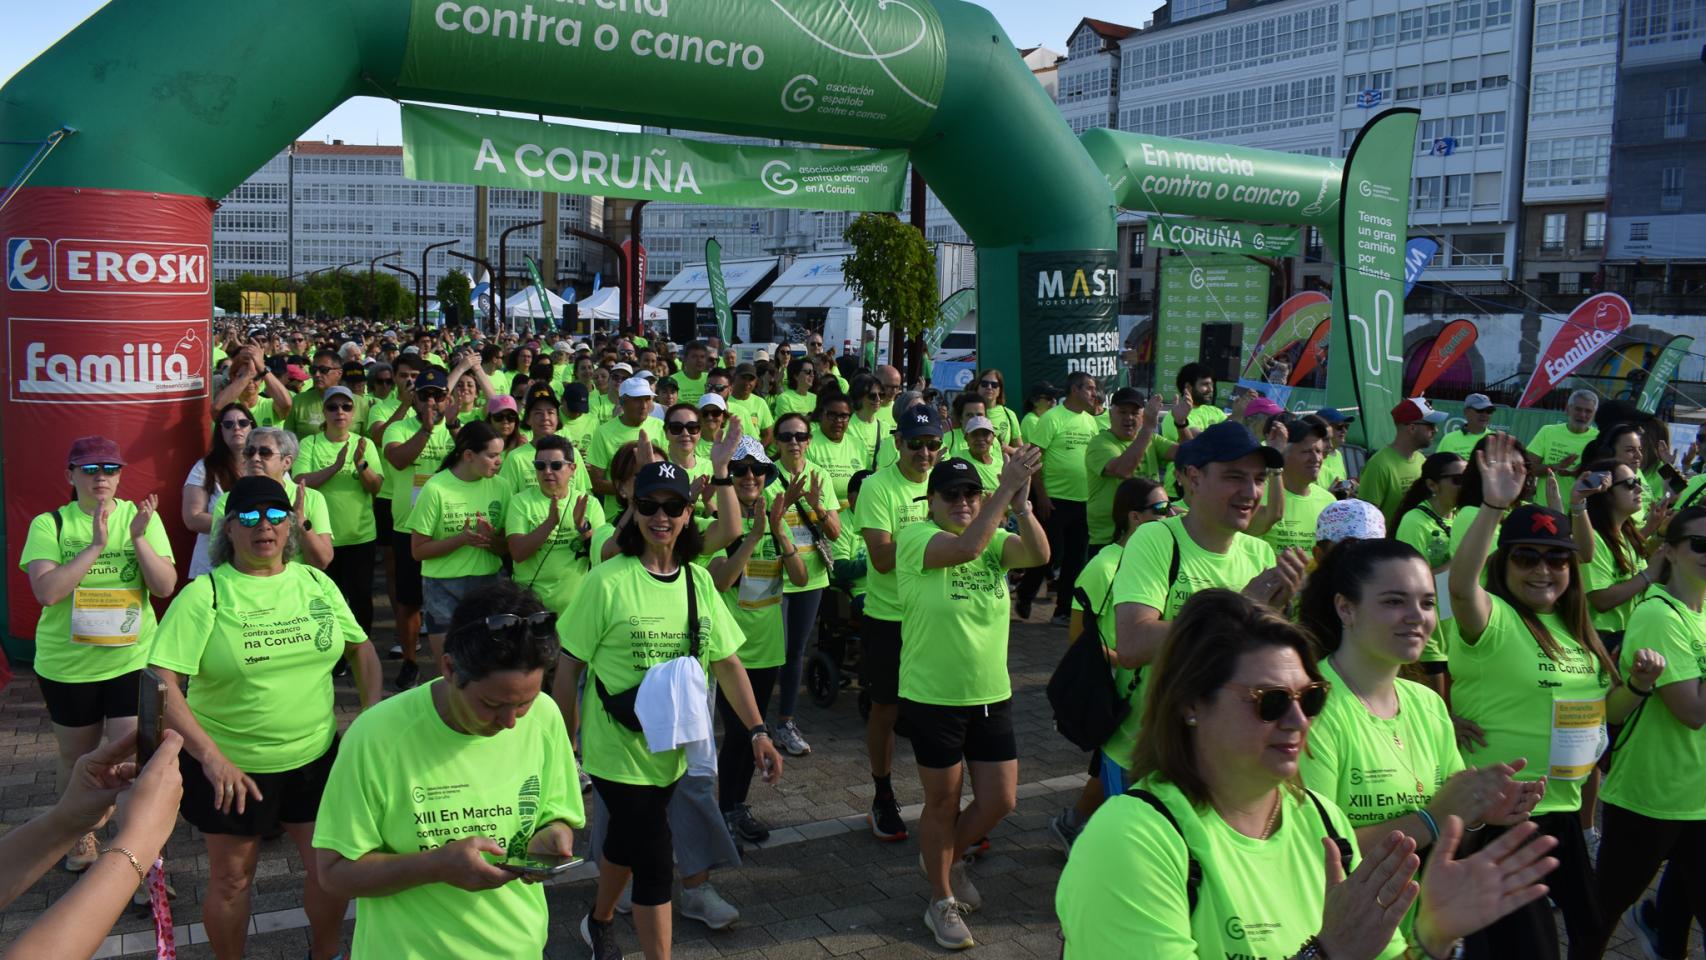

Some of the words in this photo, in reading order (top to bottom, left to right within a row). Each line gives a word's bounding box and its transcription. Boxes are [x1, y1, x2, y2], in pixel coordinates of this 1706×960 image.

[435, 1, 583, 47] contra
[593, 24, 620, 51] o
[630, 29, 765, 71] cancro
[825, 83, 875, 96] asociación
[822, 95, 864, 107] española
[817, 105, 846, 116] contra
[473, 138, 507, 173] A
[514, 143, 703, 195] CORUÑA
[1141, 143, 1170, 167] En
[1175, 150, 1255, 177] marcha
[799, 164, 849, 174] asociación
[850, 163, 888, 173] española
[841, 174, 869, 183] cancro
[818, 185, 824, 193] A
[825, 184, 856, 194] Coruña
[1142, 173, 1212, 200] contra
[1215, 183, 1229, 200] o
[1233, 184, 1300, 207] cancro
[1358, 210, 1392, 227] Temos
[1153, 224, 1164, 242] A
[1169, 225, 1242, 248] CORUÑA
[1358, 226, 1371, 236] un
[1373, 229, 1397, 242] gran
[1358, 240, 1396, 255] camiño
[1358, 253, 1376, 264] por
[67, 250, 205, 284] EROSKI
[1359, 265, 1391, 280] diante
[26, 342, 188, 383] familia
[1067, 356, 1117, 376] DIGITAL
[273, 616, 309, 627] Marcha
[243, 629, 268, 638] contra
[276, 626, 301, 635] cancro
[648, 631, 659, 639] En
[244, 640, 261, 650] na
[264, 632, 312, 648] Coruña
[632, 650, 646, 659] na
[1538, 661, 1556, 672] na
[1559, 662, 1596, 674] Coruña
[1349, 793, 1373, 808] XIII
[1376, 793, 1394, 807] En
[413, 810, 436, 825] XIII
[440, 809, 459, 822] En
[462, 804, 513, 820] Marcha
[1347, 811, 1385, 821] contra
[416, 827, 451, 838] contra
[462, 822, 497, 833] cancro
